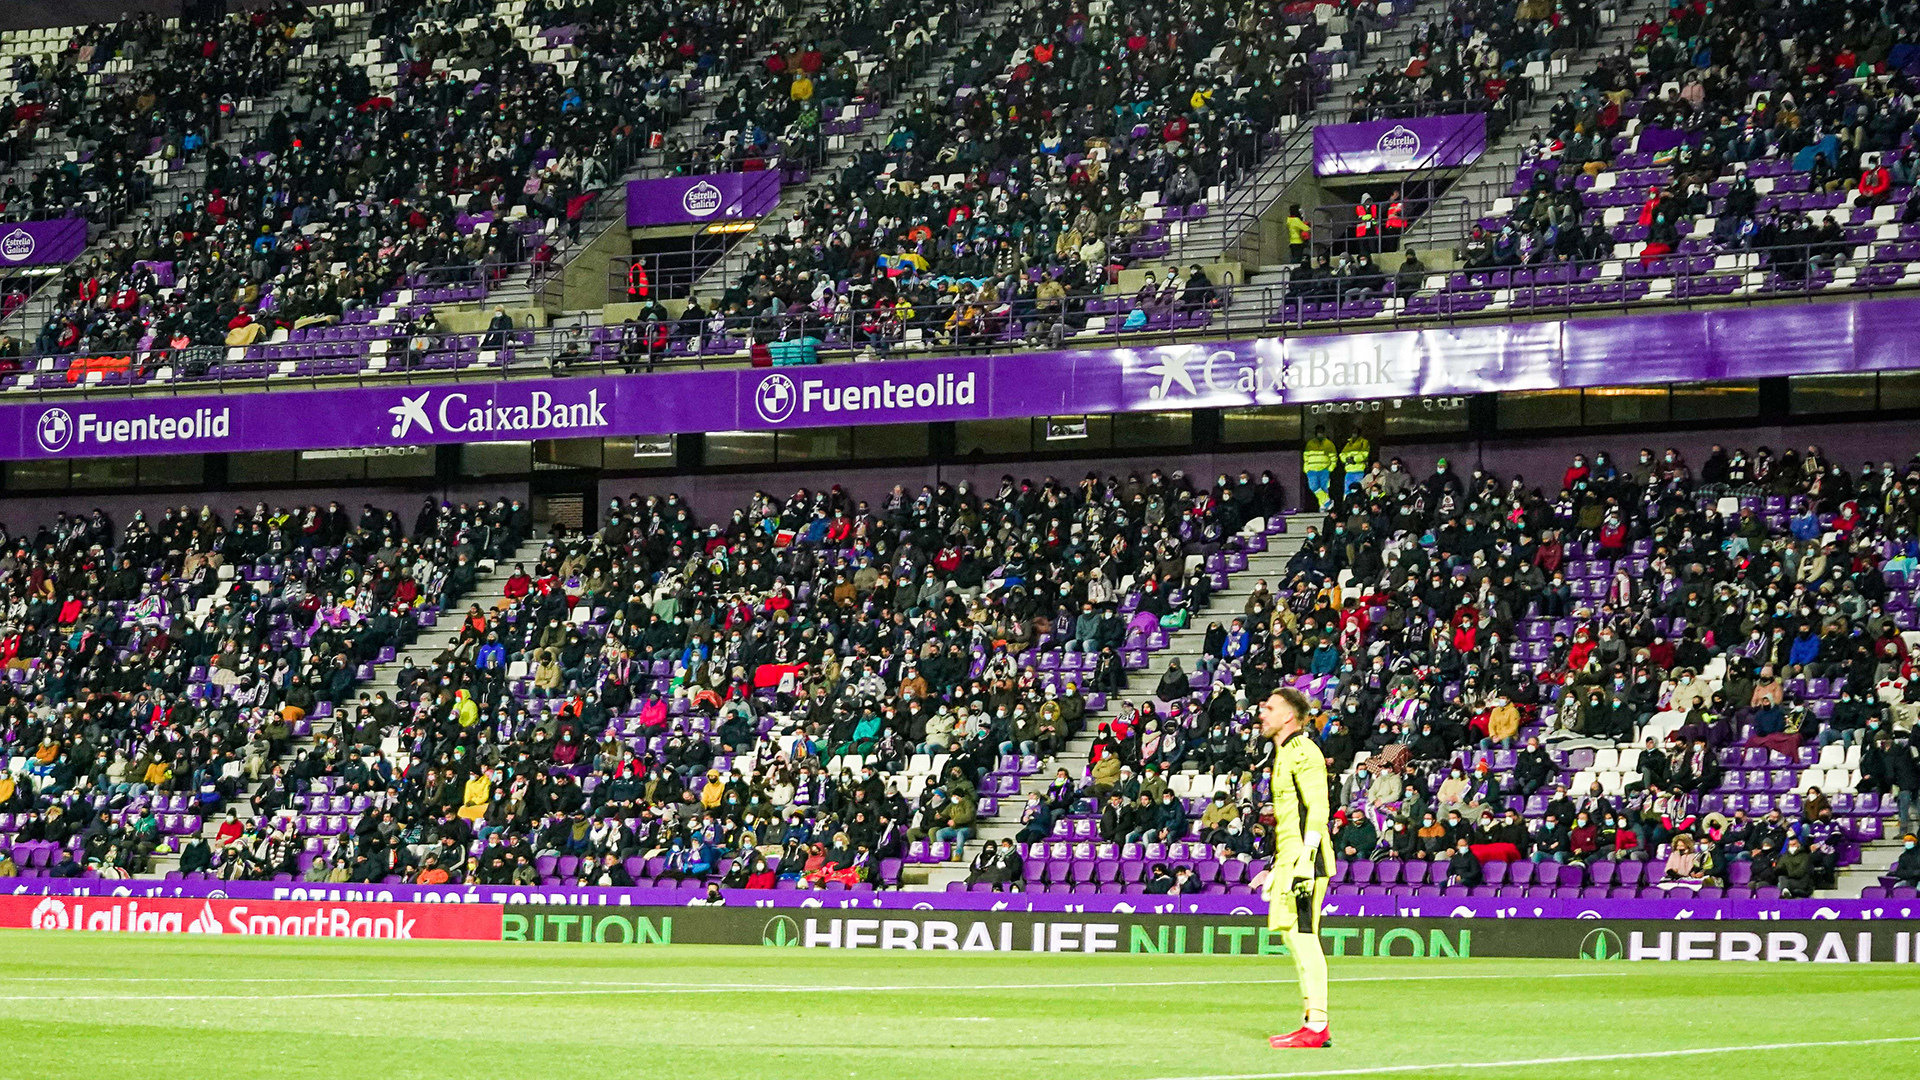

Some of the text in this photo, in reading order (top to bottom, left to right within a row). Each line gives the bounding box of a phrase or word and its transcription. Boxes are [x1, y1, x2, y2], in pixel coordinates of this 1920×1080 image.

[1383, 136, 1415, 146] Estrella
[689, 191, 717, 200] Estrella
[690, 199, 716, 208] Galicia
[5, 237, 31, 246] Estrella
[7, 246, 30, 254] Galicia
[1203, 344, 1395, 393] CaixaBank
[803, 372, 975, 413] Fuenteolid
[78, 407, 230, 443] Fuenteolid
[438, 388, 609, 433] CaixaBank
[229, 906, 416, 939] SmartBank
[1130, 925, 1471, 957] NUTRTION
[1629, 931, 1920, 962] HERBALI
